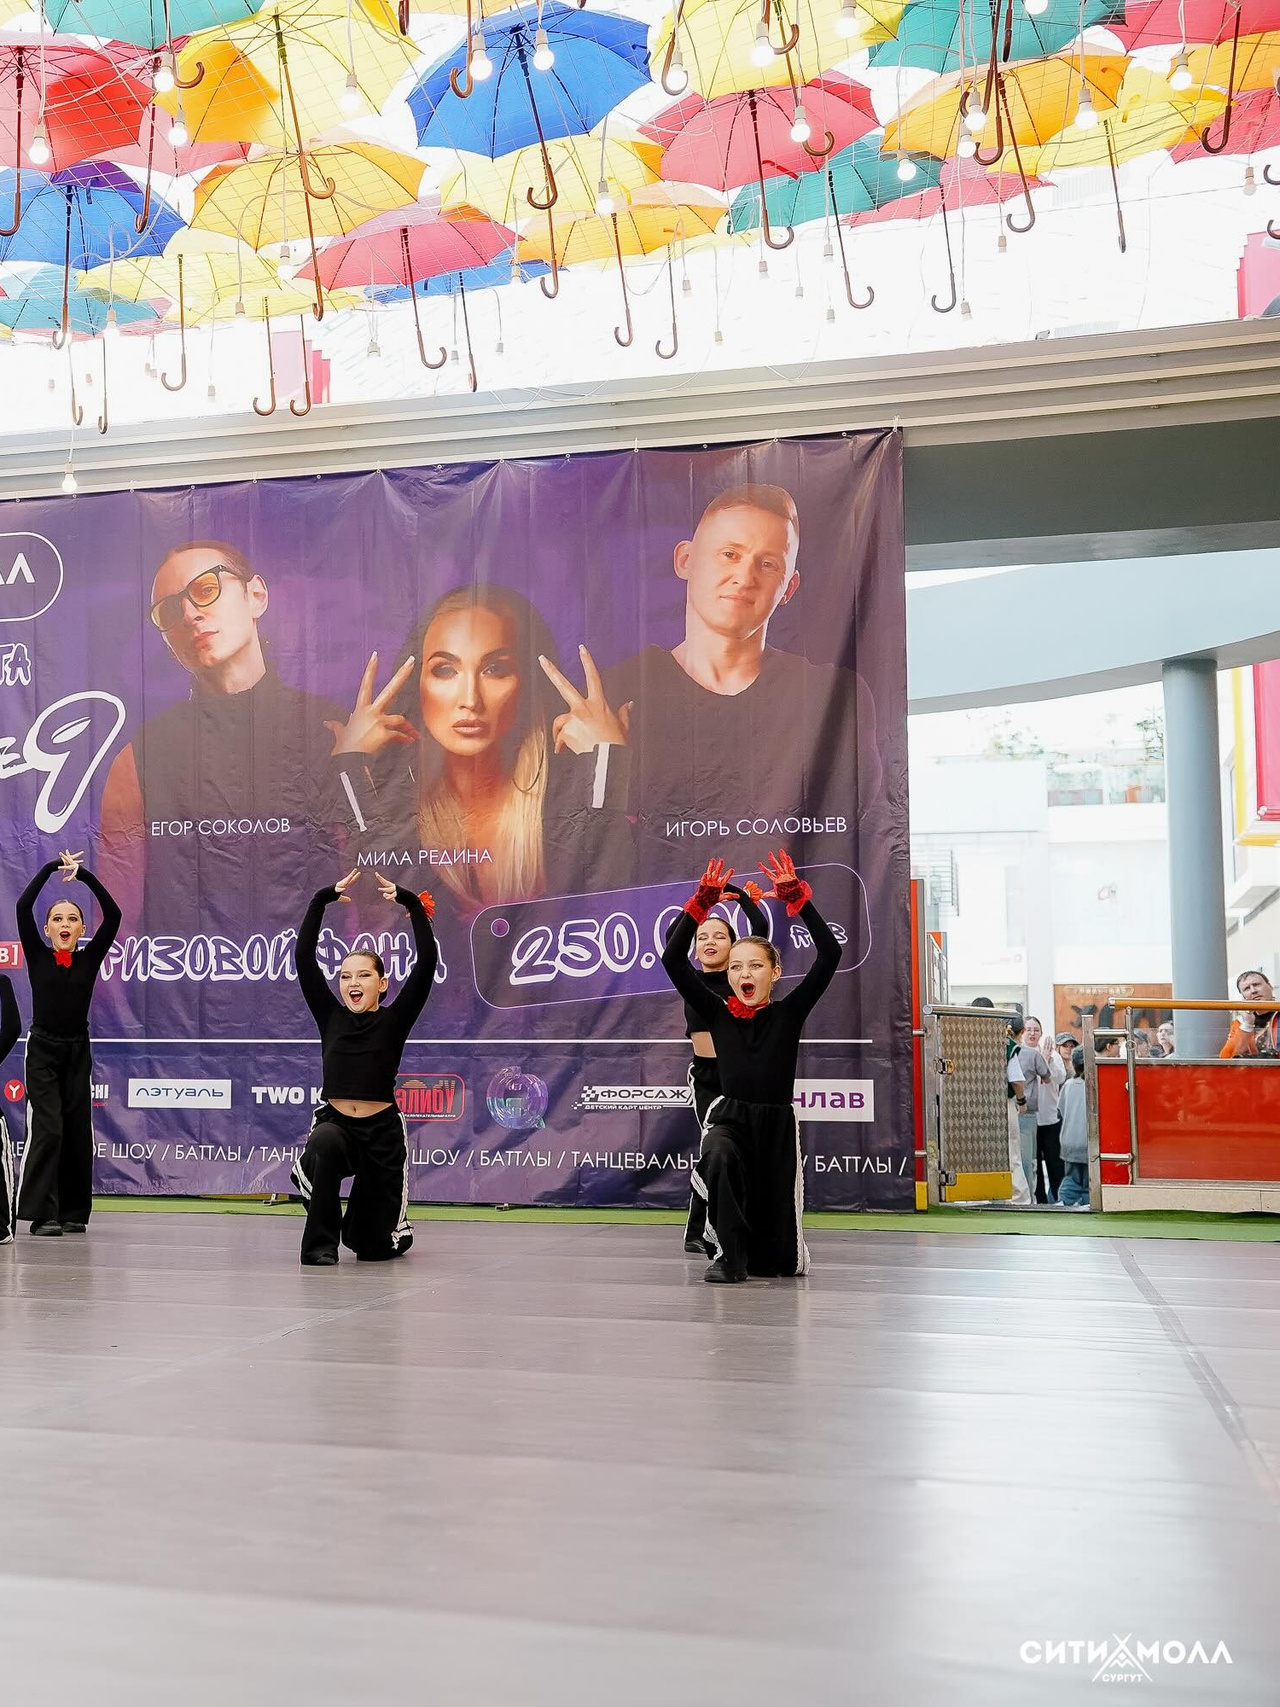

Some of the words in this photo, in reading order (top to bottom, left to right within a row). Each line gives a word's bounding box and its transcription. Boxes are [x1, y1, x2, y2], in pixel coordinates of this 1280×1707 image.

[151, 820, 193, 836] ЕГОР
[198, 818, 291, 835] СОКОЛОВ
[666, 820, 730, 837] ИГОРЬ
[736, 817, 847, 836] СОЛОВЬЕВ
[356, 851, 413, 868] МИЛА
[419, 849, 493, 866] РЕДИНА
[509, 896, 775, 986] 250.
[78, 928, 298, 982] РИЗОВОЙ
[251, 1086, 305, 1105] TWO
[600, 1089, 688, 1099] ФОРСАЖ
[112, 1143, 157, 1160] ШОУ
[175, 1144, 241, 1161] БАТТЛЫ
[412, 1149, 460, 1166] ШОУ
[480, 1150, 551, 1167] БАТТЛЫ
[571, 1151, 701, 1171] ТАНЦЕВАЛЬН
[815, 1155, 892, 1174] БАТТЛЫ
